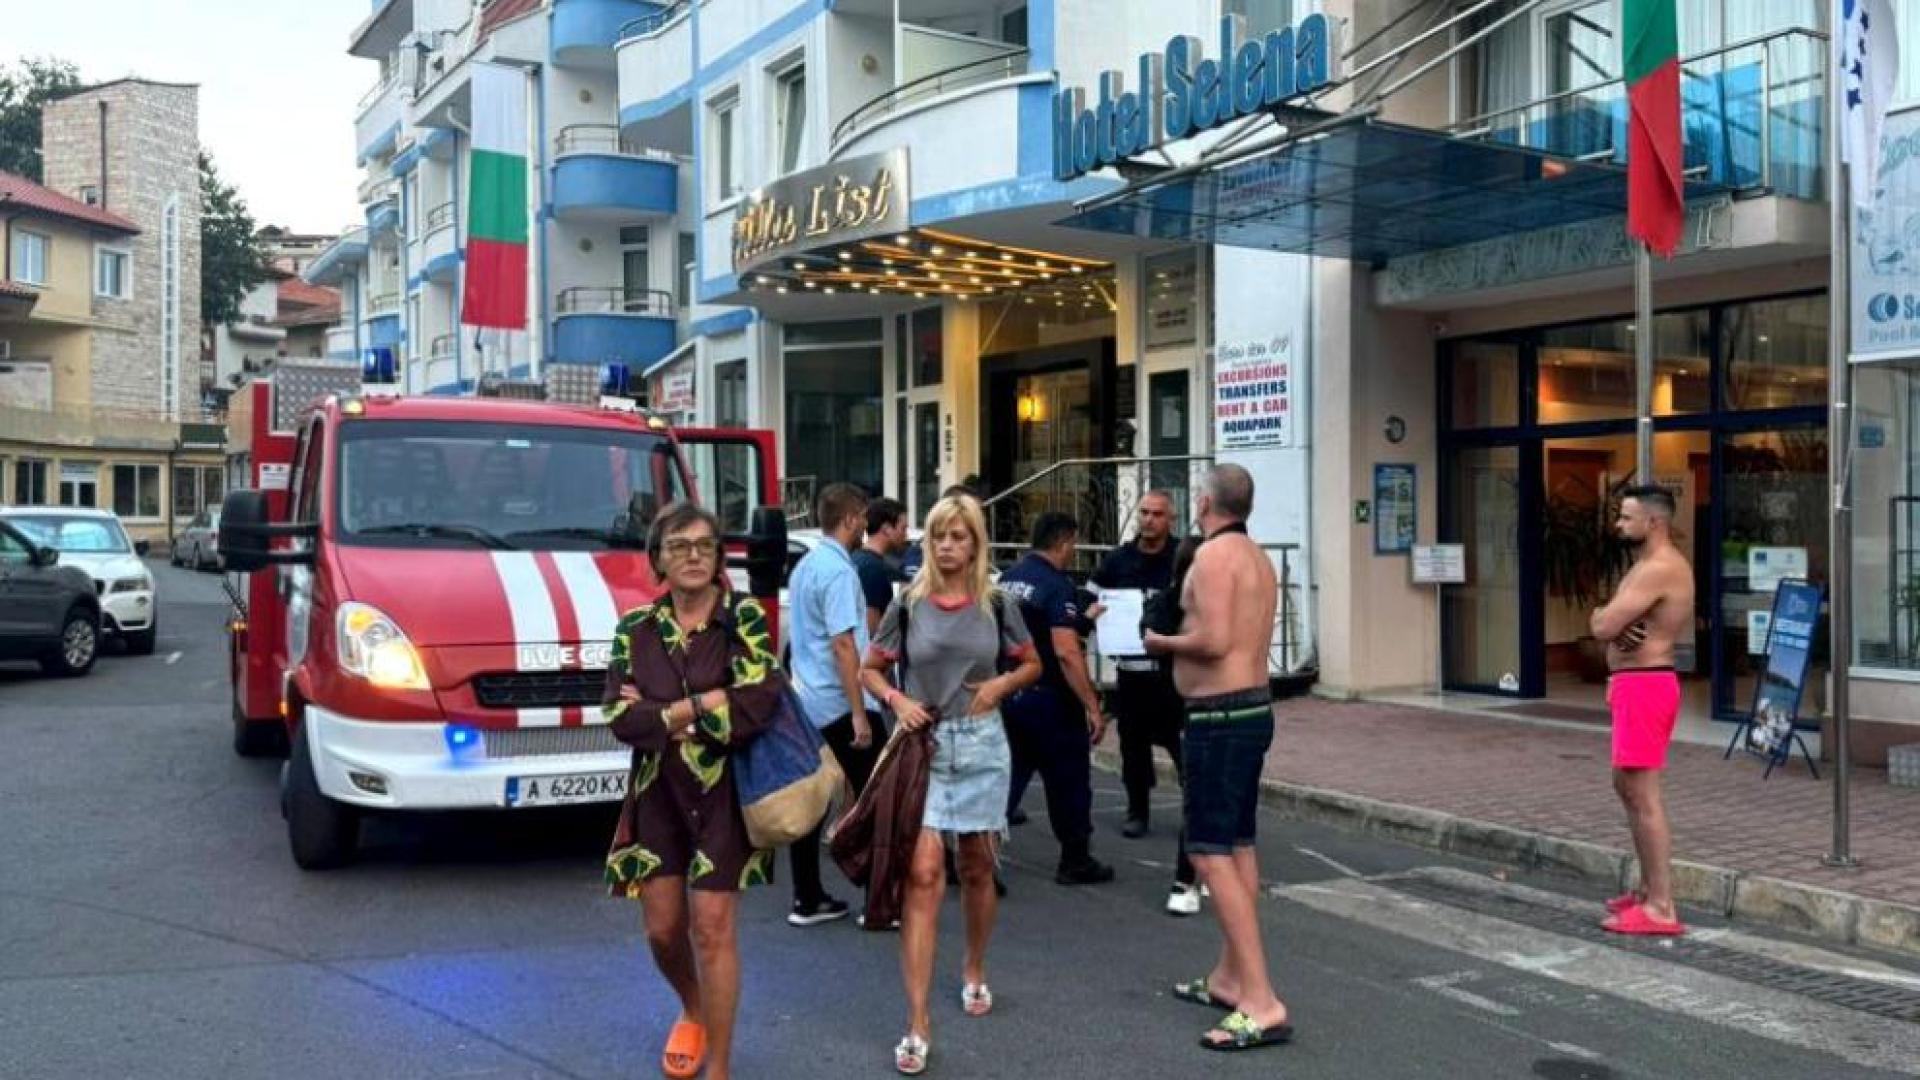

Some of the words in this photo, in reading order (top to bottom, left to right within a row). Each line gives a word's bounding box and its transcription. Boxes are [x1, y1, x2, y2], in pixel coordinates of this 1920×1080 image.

[1052, 53, 1154, 181] Hotel
[1165, 13, 1332, 138] Selena
[805, 168, 892, 236] List
[1218, 364, 1287, 384] EXCURSIONS
[1219, 380, 1287, 400] TRANSFERS
[1218, 402, 1245, 417] RENT
[1250, 401, 1258, 414] A
[1263, 398, 1287, 413] CAR
[1222, 417, 1281, 433] AQUAPARK
[527, 780, 539, 798] A
